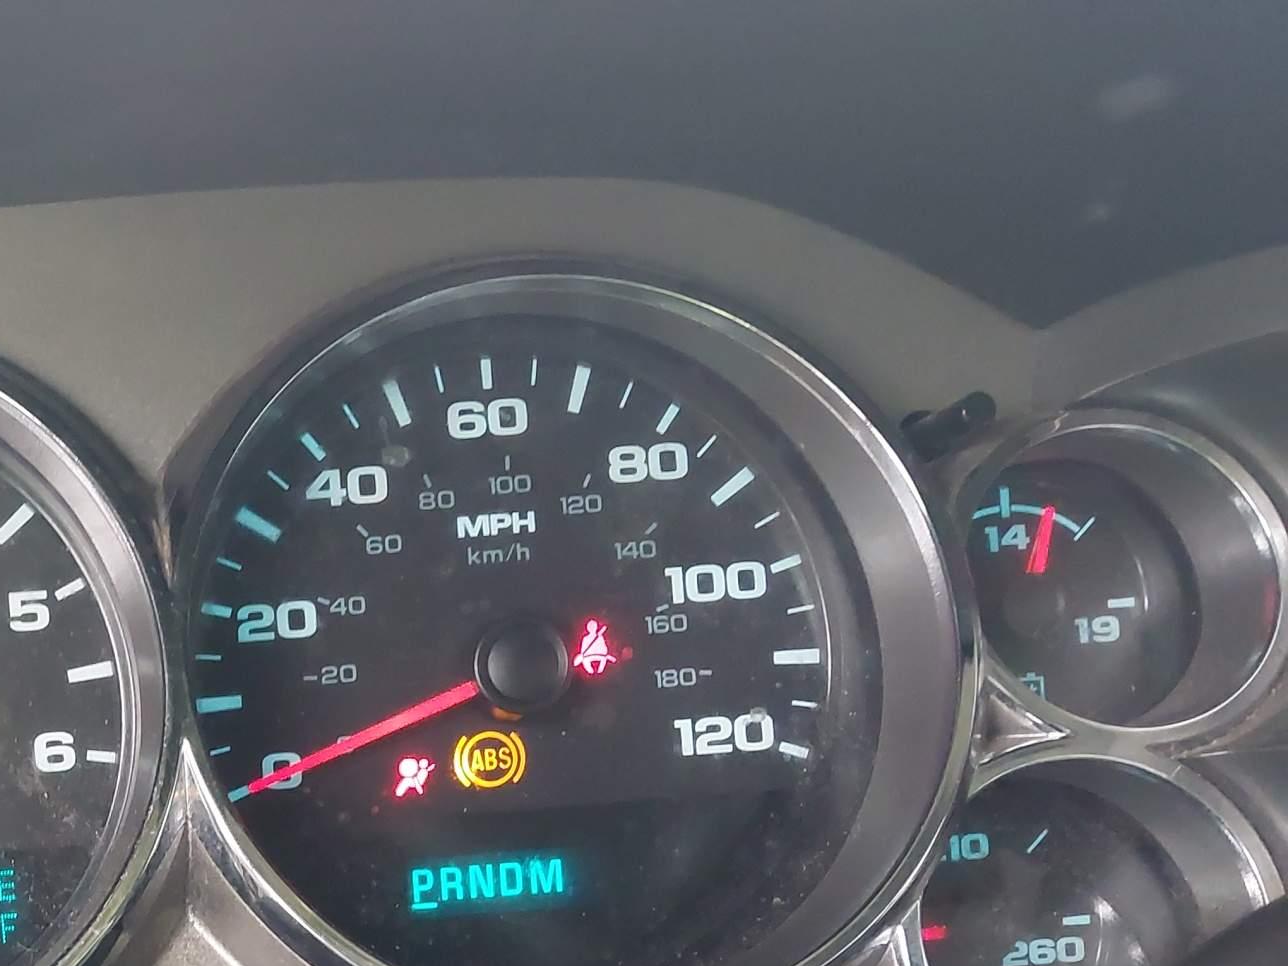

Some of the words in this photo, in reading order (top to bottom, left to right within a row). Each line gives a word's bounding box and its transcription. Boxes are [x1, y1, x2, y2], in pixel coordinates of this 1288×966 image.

[445, 397, 530, 440] 60
[607, 440, 690, 484] 80
[304, 464, 390, 508] 40
[417, 488, 457, 511] 80
[487, 473, 533, 496] 100
[558, 492, 604, 516] 120
[455, 510, 538, 540] MPH
[983, 525, 1031, 553] 14
[364, 532, 404, 556] 60
[465, 543, 532, 568] km/h
[614, 539, 658, 562] 140
[663, 560, 769, 605] 100
[7, 589, 51, 632] 5
[234, 599, 319, 643] 20
[327, 595, 368, 618] 40
[644, 612, 690, 636] 160
[1073, 615, 1122, 645] 19
[319, 663, 359, 687] 20
[654, 666, 698, 690] 180
[673, 712, 774, 757] 120
[32, 730, 76, 774] 6
[470, 743, 514, 774] ABS
[262, 751, 304, 790] 0
[940, 832, 990, 862] 10
[411, 857, 565, 906] PRNDM
